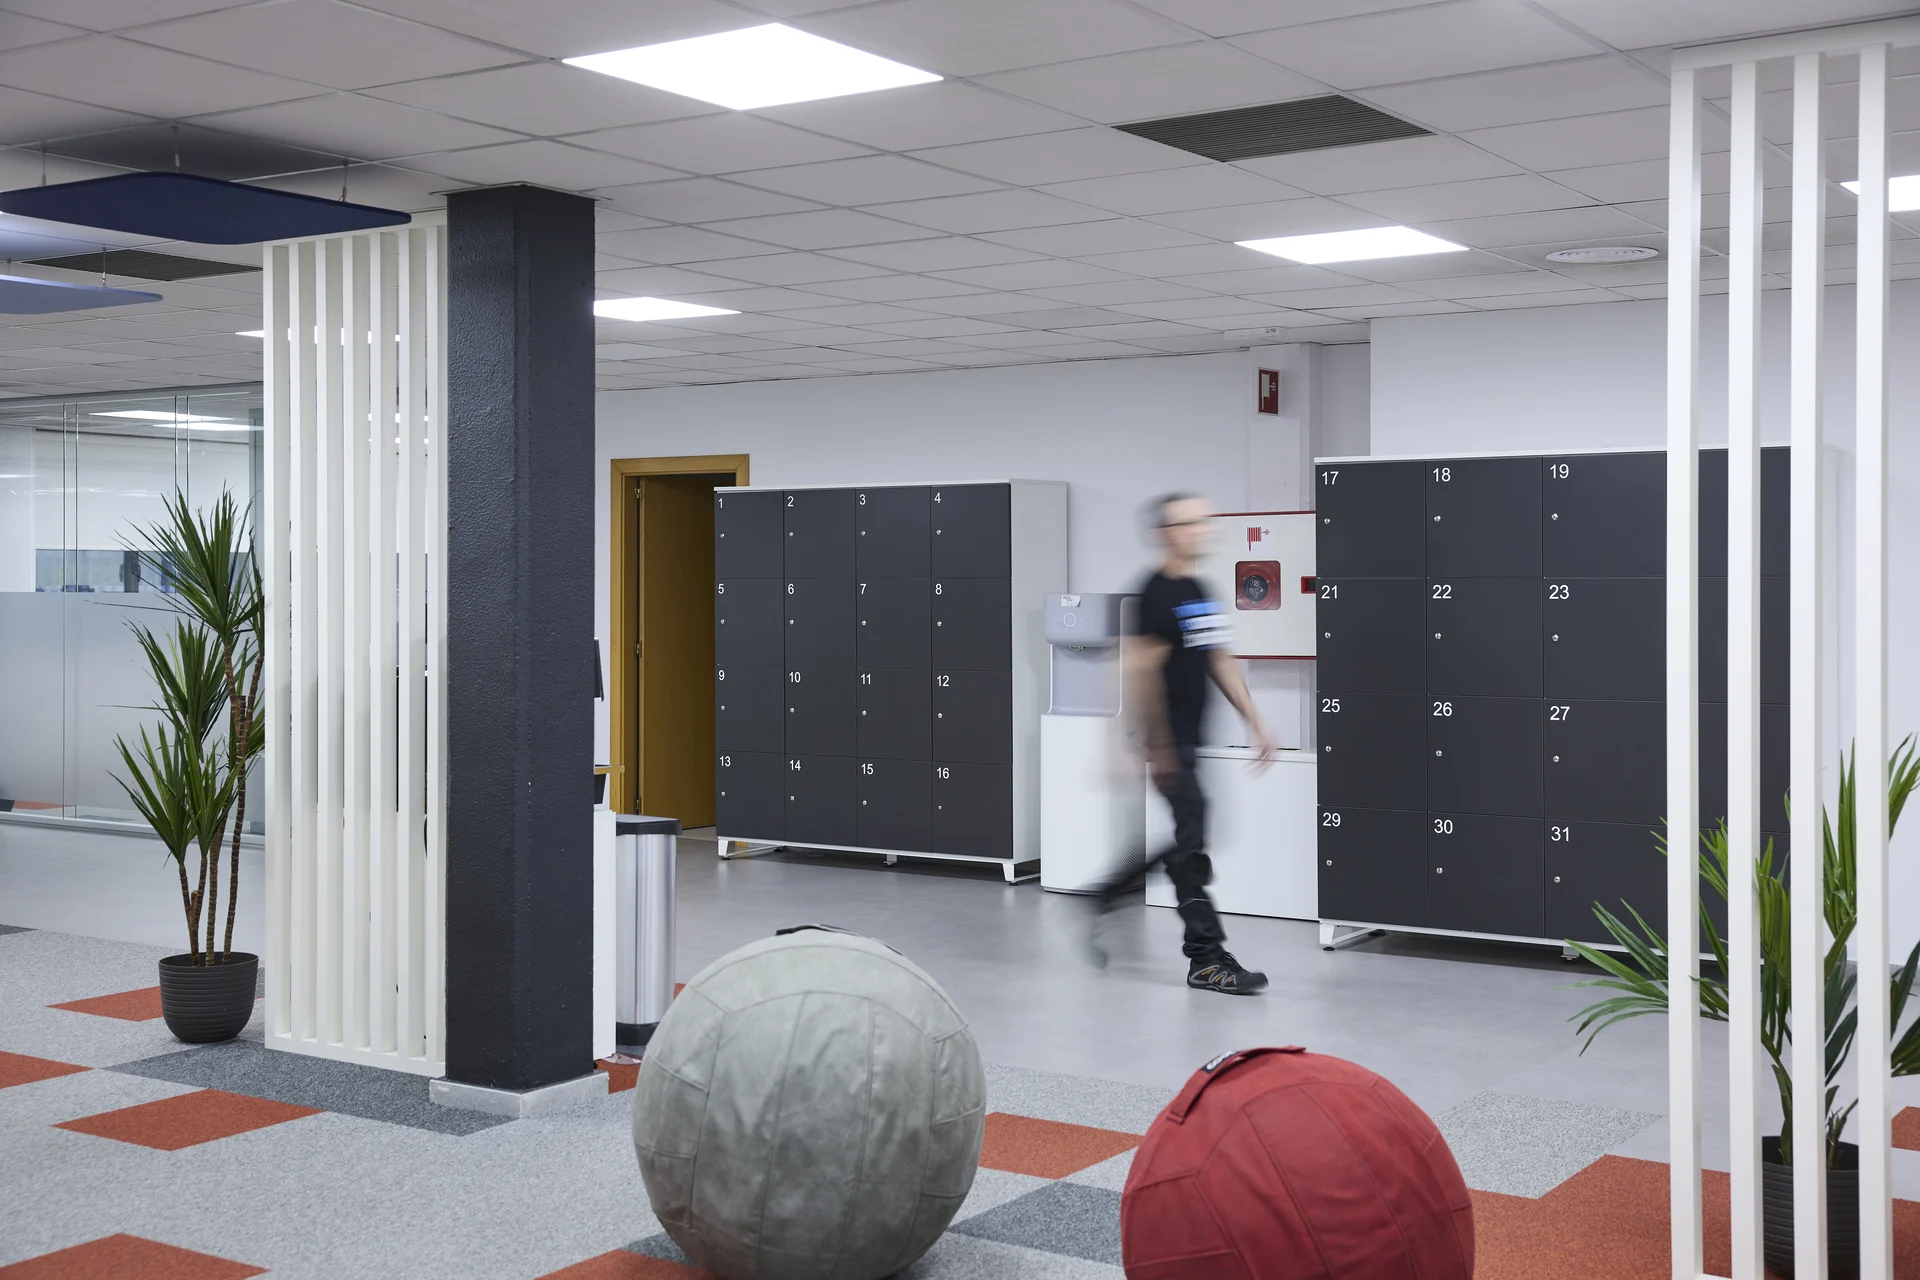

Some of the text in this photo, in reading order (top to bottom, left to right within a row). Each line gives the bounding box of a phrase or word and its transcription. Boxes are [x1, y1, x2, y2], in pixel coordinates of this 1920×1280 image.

[1433, 467, 1451, 483] 18
[1550, 463, 1570, 479] 19
[1322, 470, 1339, 486] 17
[787, 495, 794, 507] 2
[859, 493, 866, 506] 3
[933, 491, 942, 504] 4
[717, 583, 725, 595] 5
[787, 583, 795, 595] 6
[859, 583, 867, 595] 7
[935, 583, 943, 596] 8
[1322, 584, 1338, 600] 21
[1433, 584, 1452, 599] 22
[1549, 584, 1570, 600] 23
[718, 669, 725, 681] 9
[789, 671, 801, 683] 10
[860, 673, 871, 685] 11
[936, 674, 950, 687] 12
[1322, 698, 1341, 713] 25
[1433, 701, 1453, 717] 26
[1550, 705, 1571, 721] 27
[719, 755, 731, 767] 13
[789, 759, 802, 771] 14
[861, 763, 874, 775] 15
[936, 766, 950, 780] 16
[1323, 812, 1341, 828] 29
[1434, 818, 1454, 835] 30
[1551, 825, 1569, 842] 31
